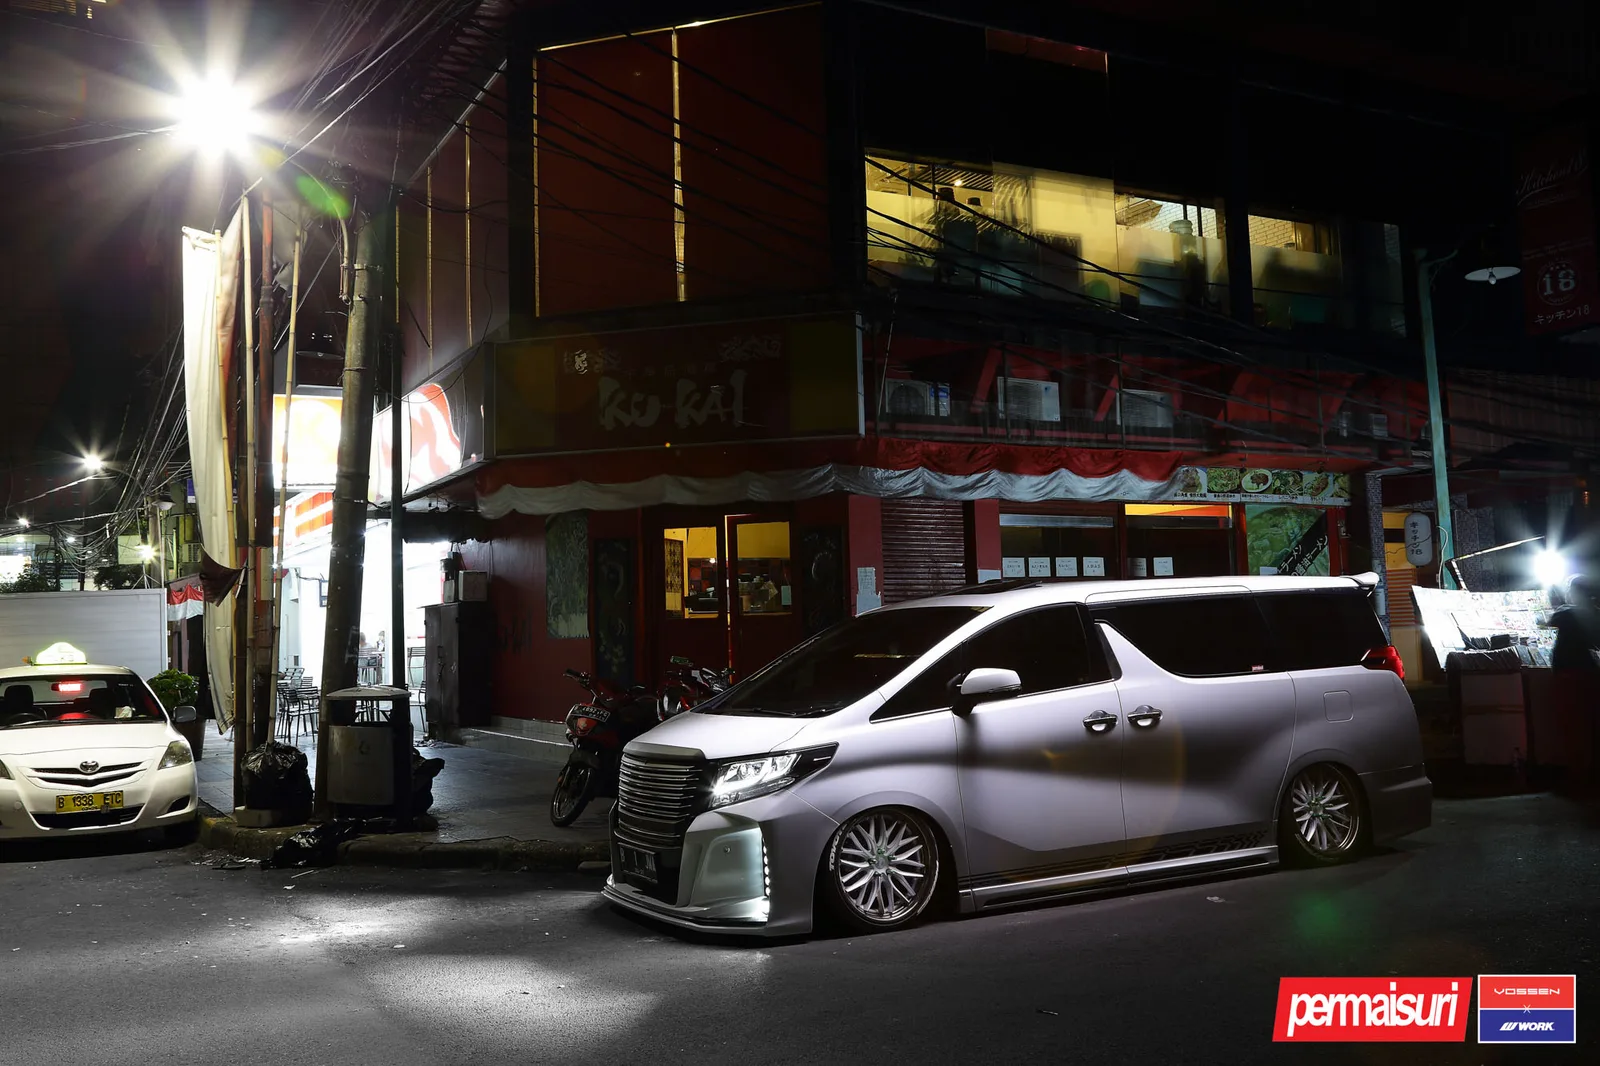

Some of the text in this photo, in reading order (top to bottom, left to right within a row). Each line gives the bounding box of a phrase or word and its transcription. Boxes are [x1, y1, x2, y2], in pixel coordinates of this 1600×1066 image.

[1542, 269, 1576, 295] 18
[58, 792, 121, 809] B 1338 ETC
